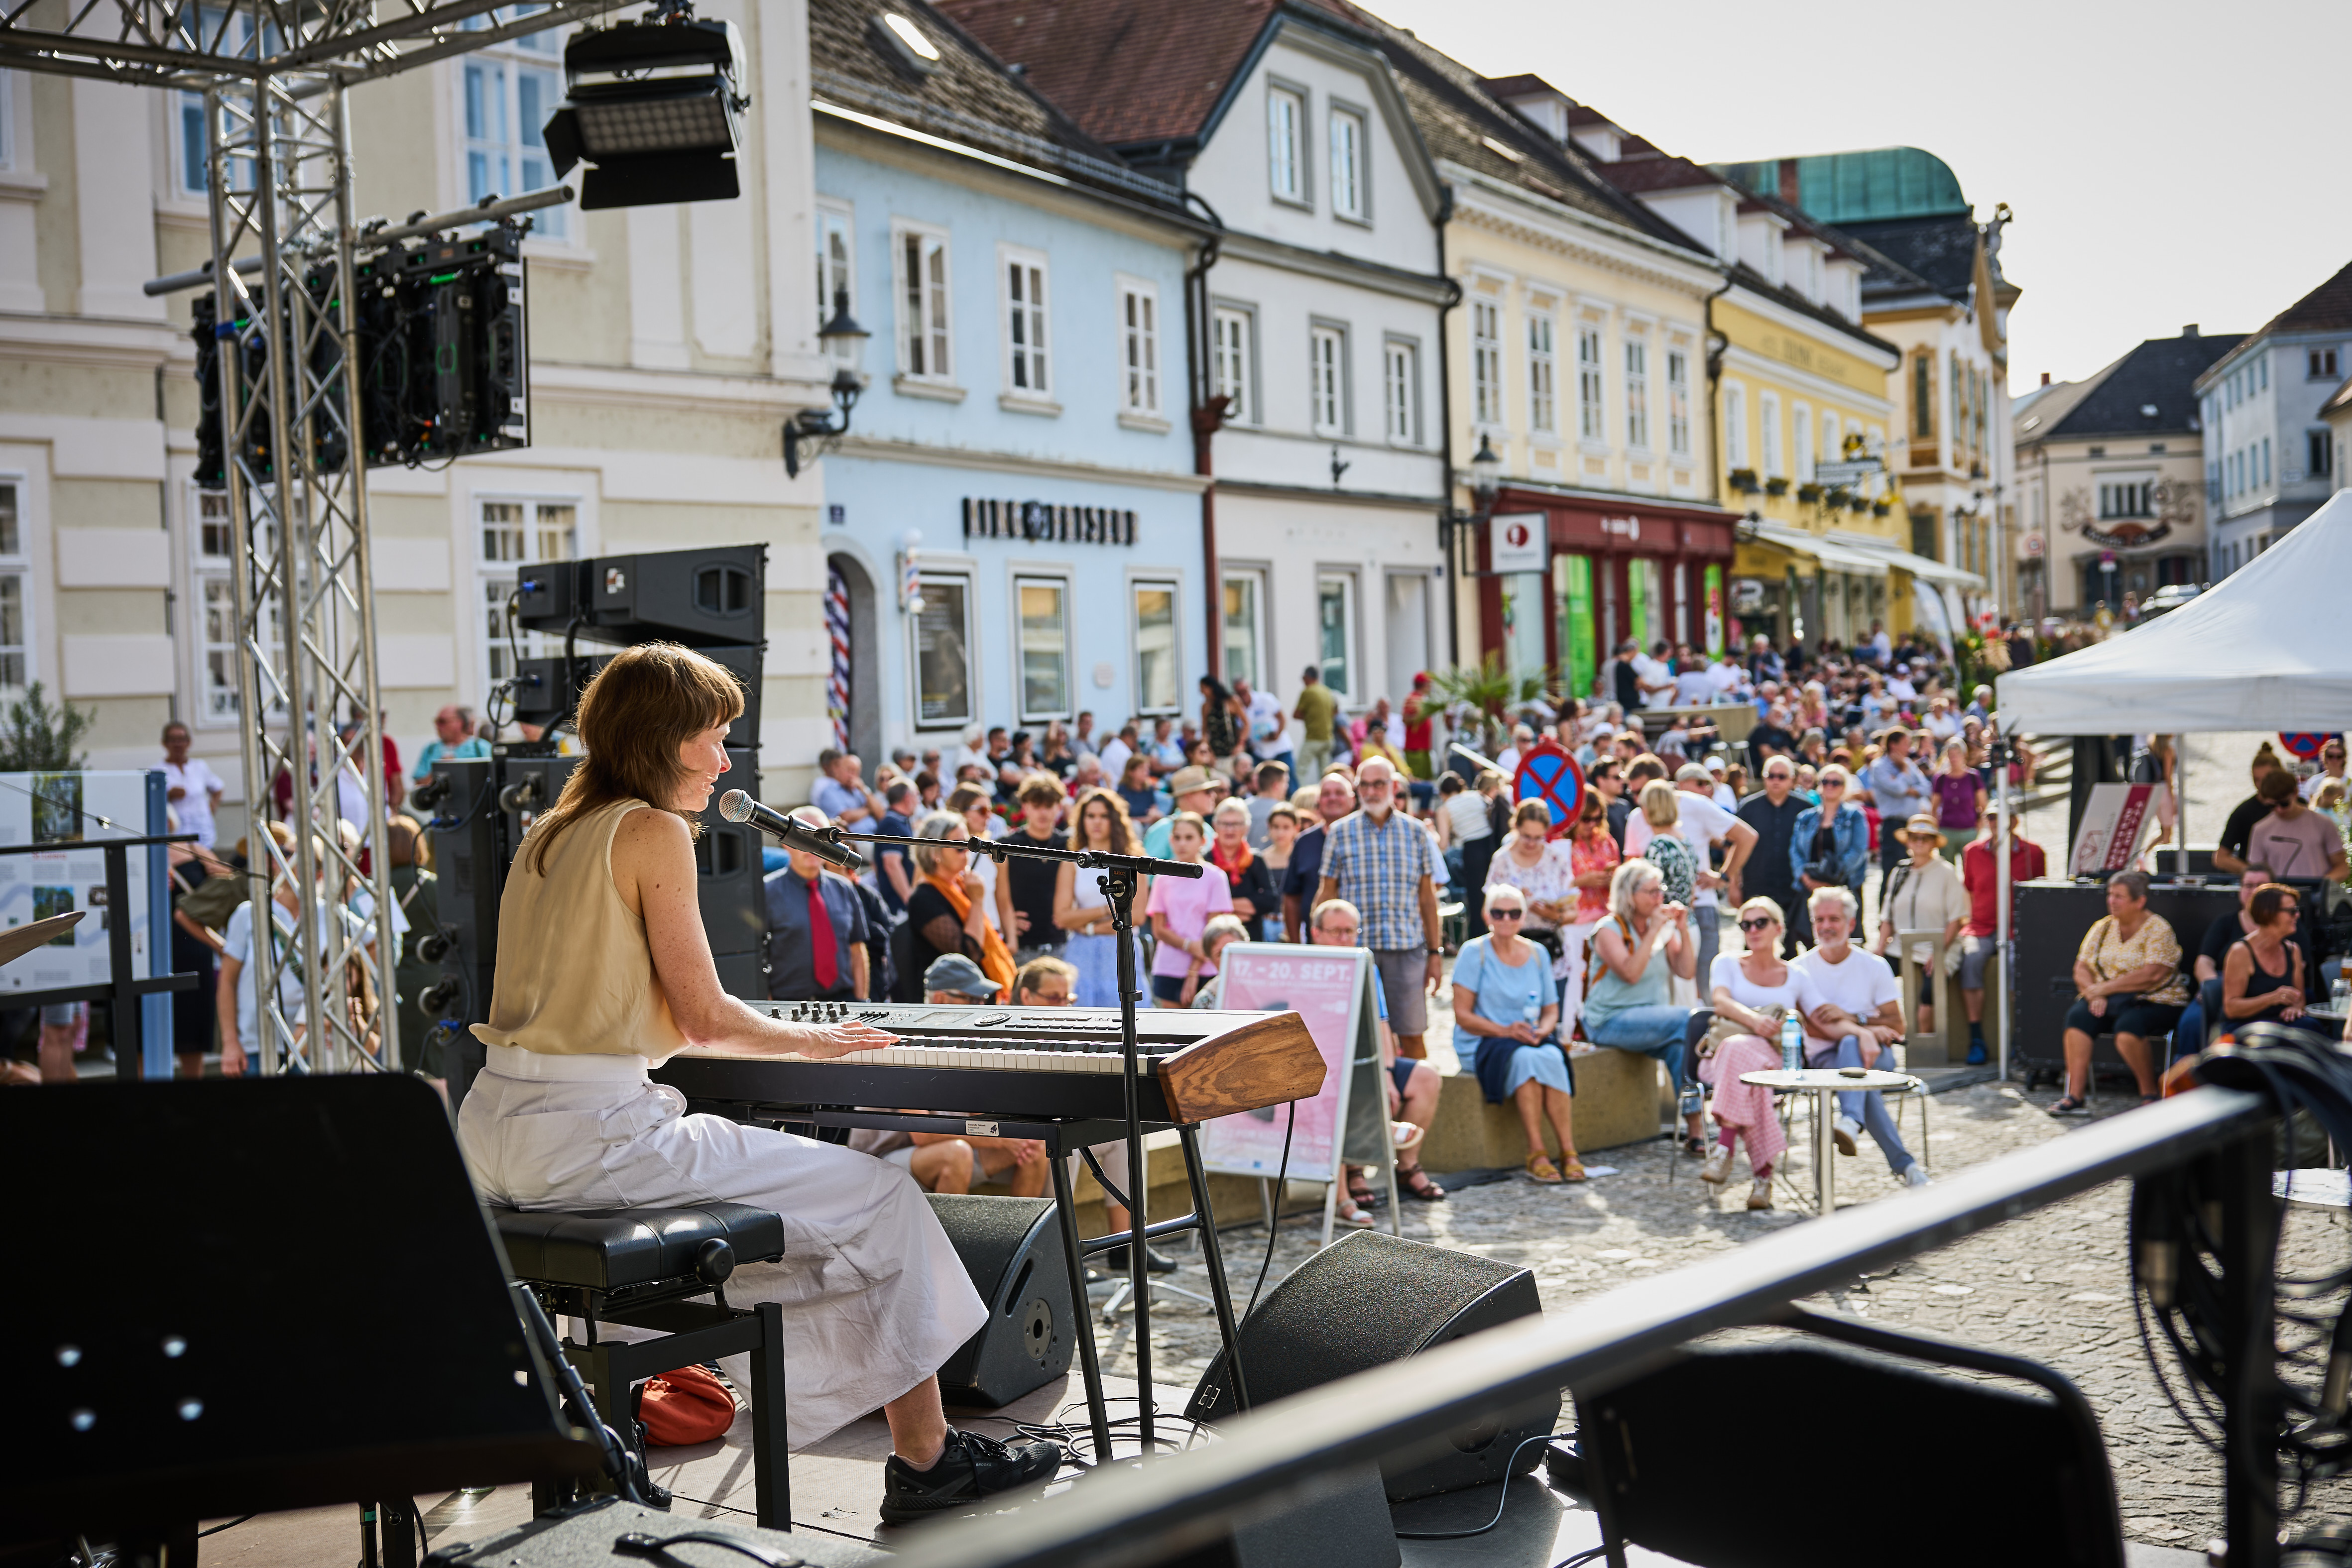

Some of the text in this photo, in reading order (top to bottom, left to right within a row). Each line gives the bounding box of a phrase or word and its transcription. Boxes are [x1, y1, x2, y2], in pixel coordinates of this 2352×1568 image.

[1233, 961, 1252, 977] 17.
[1269, 962, 1294, 979] 20.
[1300, 963, 1351, 981] SEPT.
